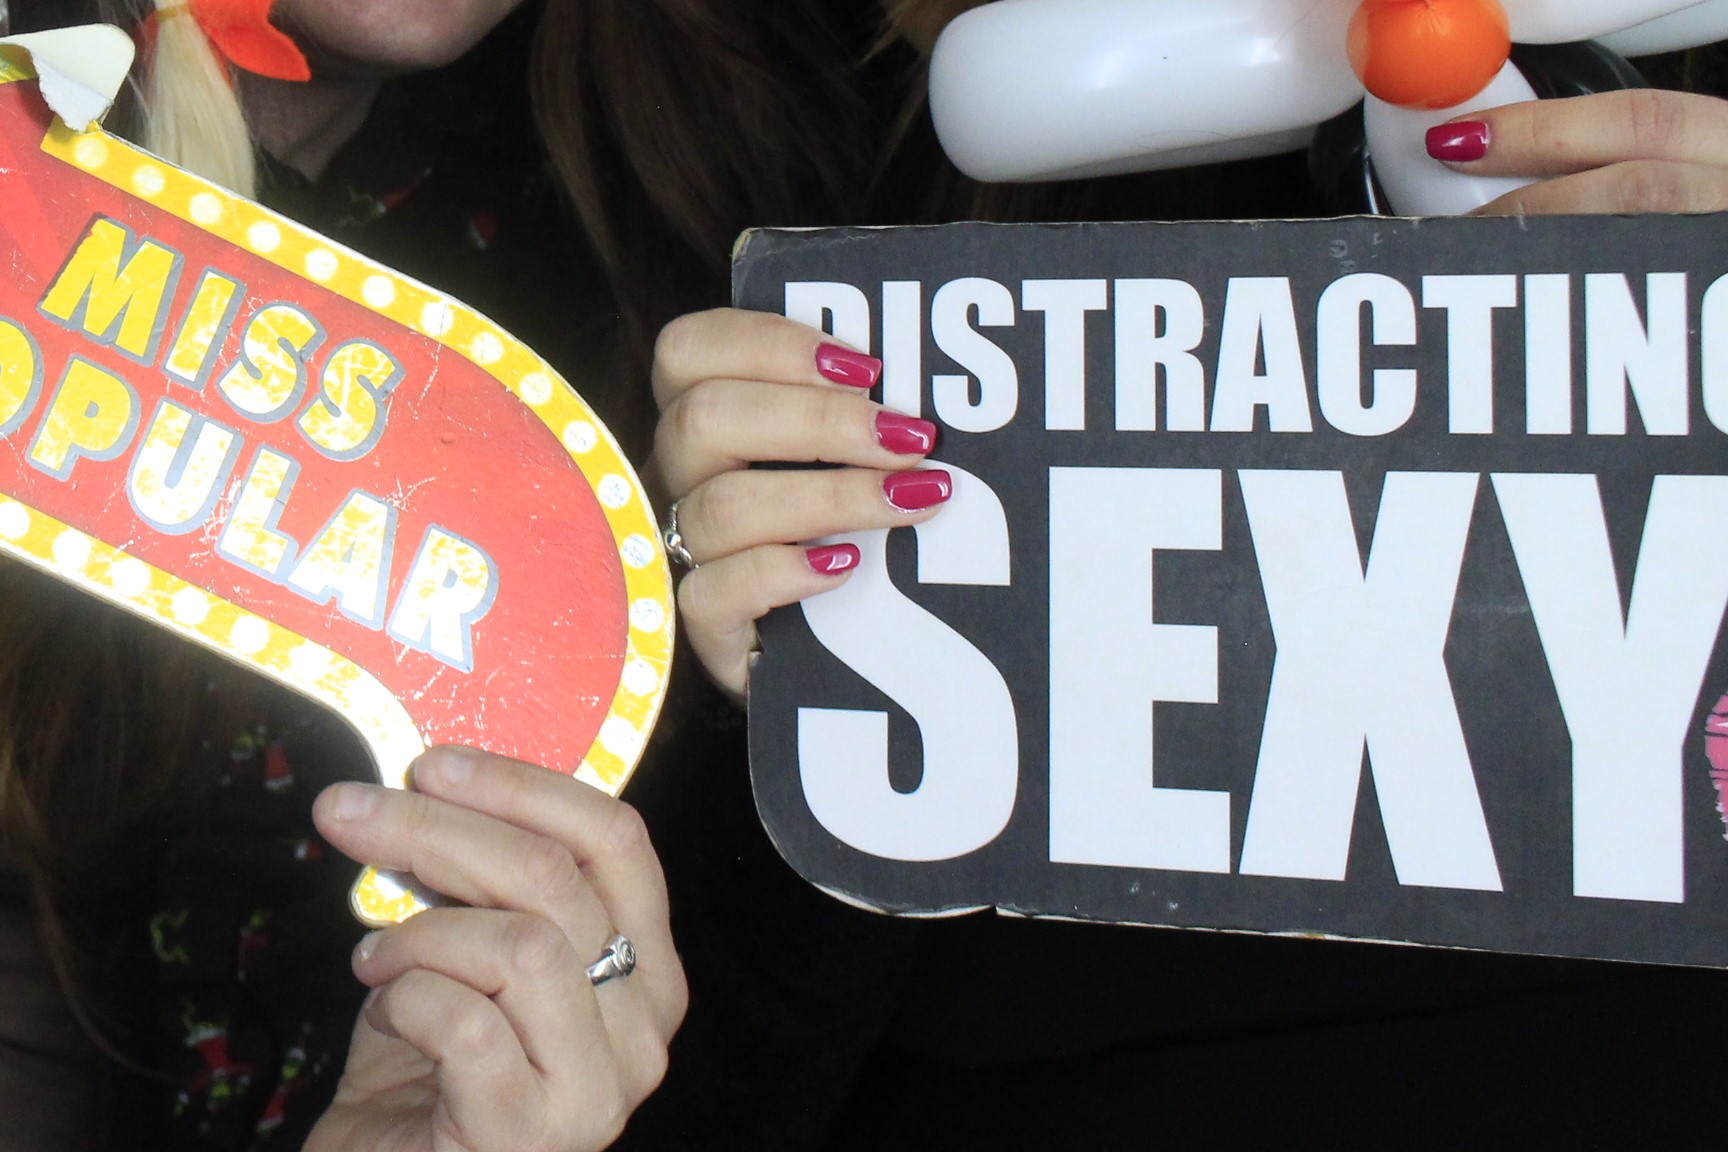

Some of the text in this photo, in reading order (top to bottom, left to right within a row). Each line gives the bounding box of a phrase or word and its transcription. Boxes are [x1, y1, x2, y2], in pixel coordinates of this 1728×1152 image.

[40, 214, 400, 459] MISS
[784, 271, 1728, 437] ISTRACTIN
[796, 458, 1728, 904] SEXY
